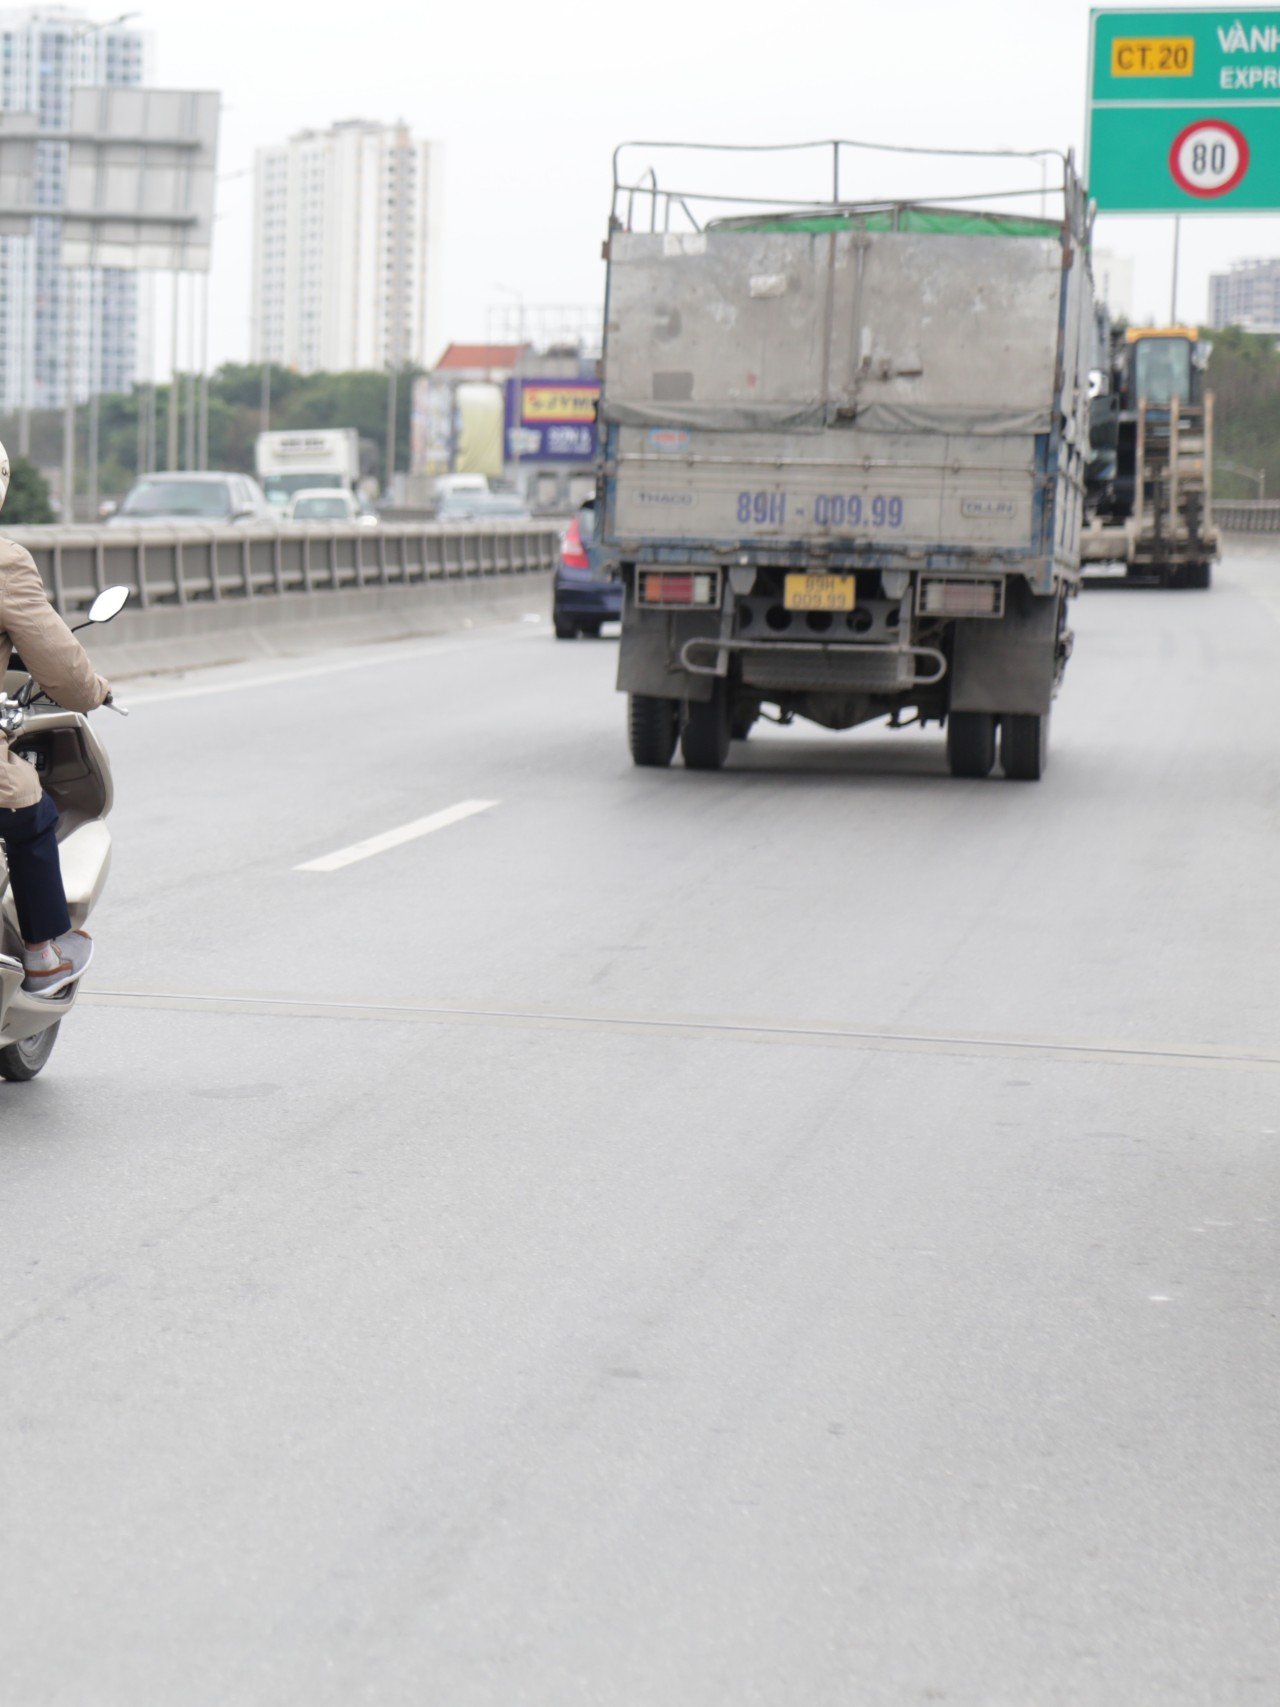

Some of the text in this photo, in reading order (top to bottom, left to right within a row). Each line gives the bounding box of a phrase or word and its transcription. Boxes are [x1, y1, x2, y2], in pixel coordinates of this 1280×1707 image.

[1192, 141, 1226, 175] 80
[737, 491, 787, 525] 89H
[814, 493, 904, 528] 009.99
